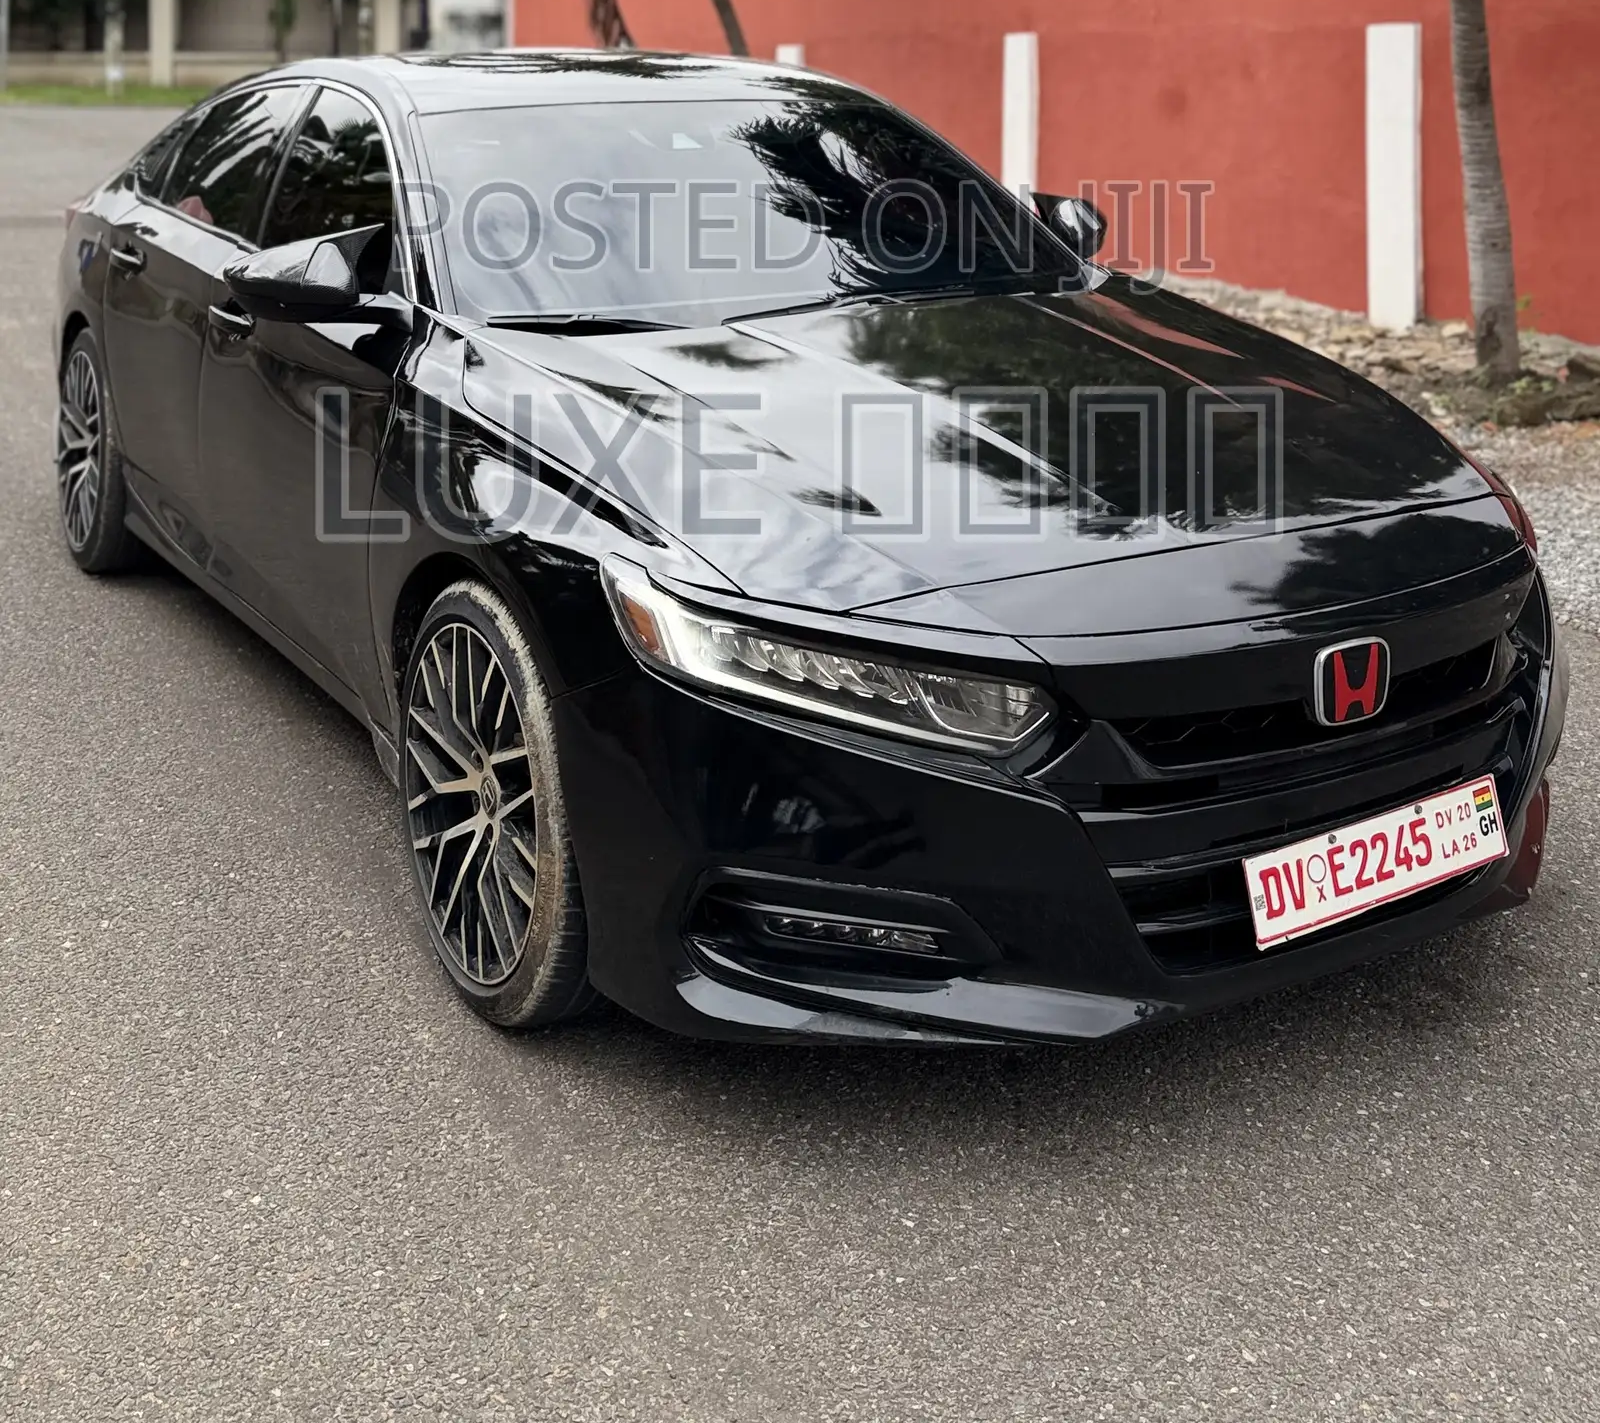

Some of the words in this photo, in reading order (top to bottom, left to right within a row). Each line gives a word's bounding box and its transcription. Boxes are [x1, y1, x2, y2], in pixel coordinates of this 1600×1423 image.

[1435, 808, 1452, 829] DV
[1457, 802, 1471, 821] 20
[1480, 811, 1499, 836] GH
[1442, 839, 1460, 859] LA
[1463, 832, 1477, 851] 26
[1259, 858, 1306, 921] DV
[1327, 817, 1432, 897] E2245
